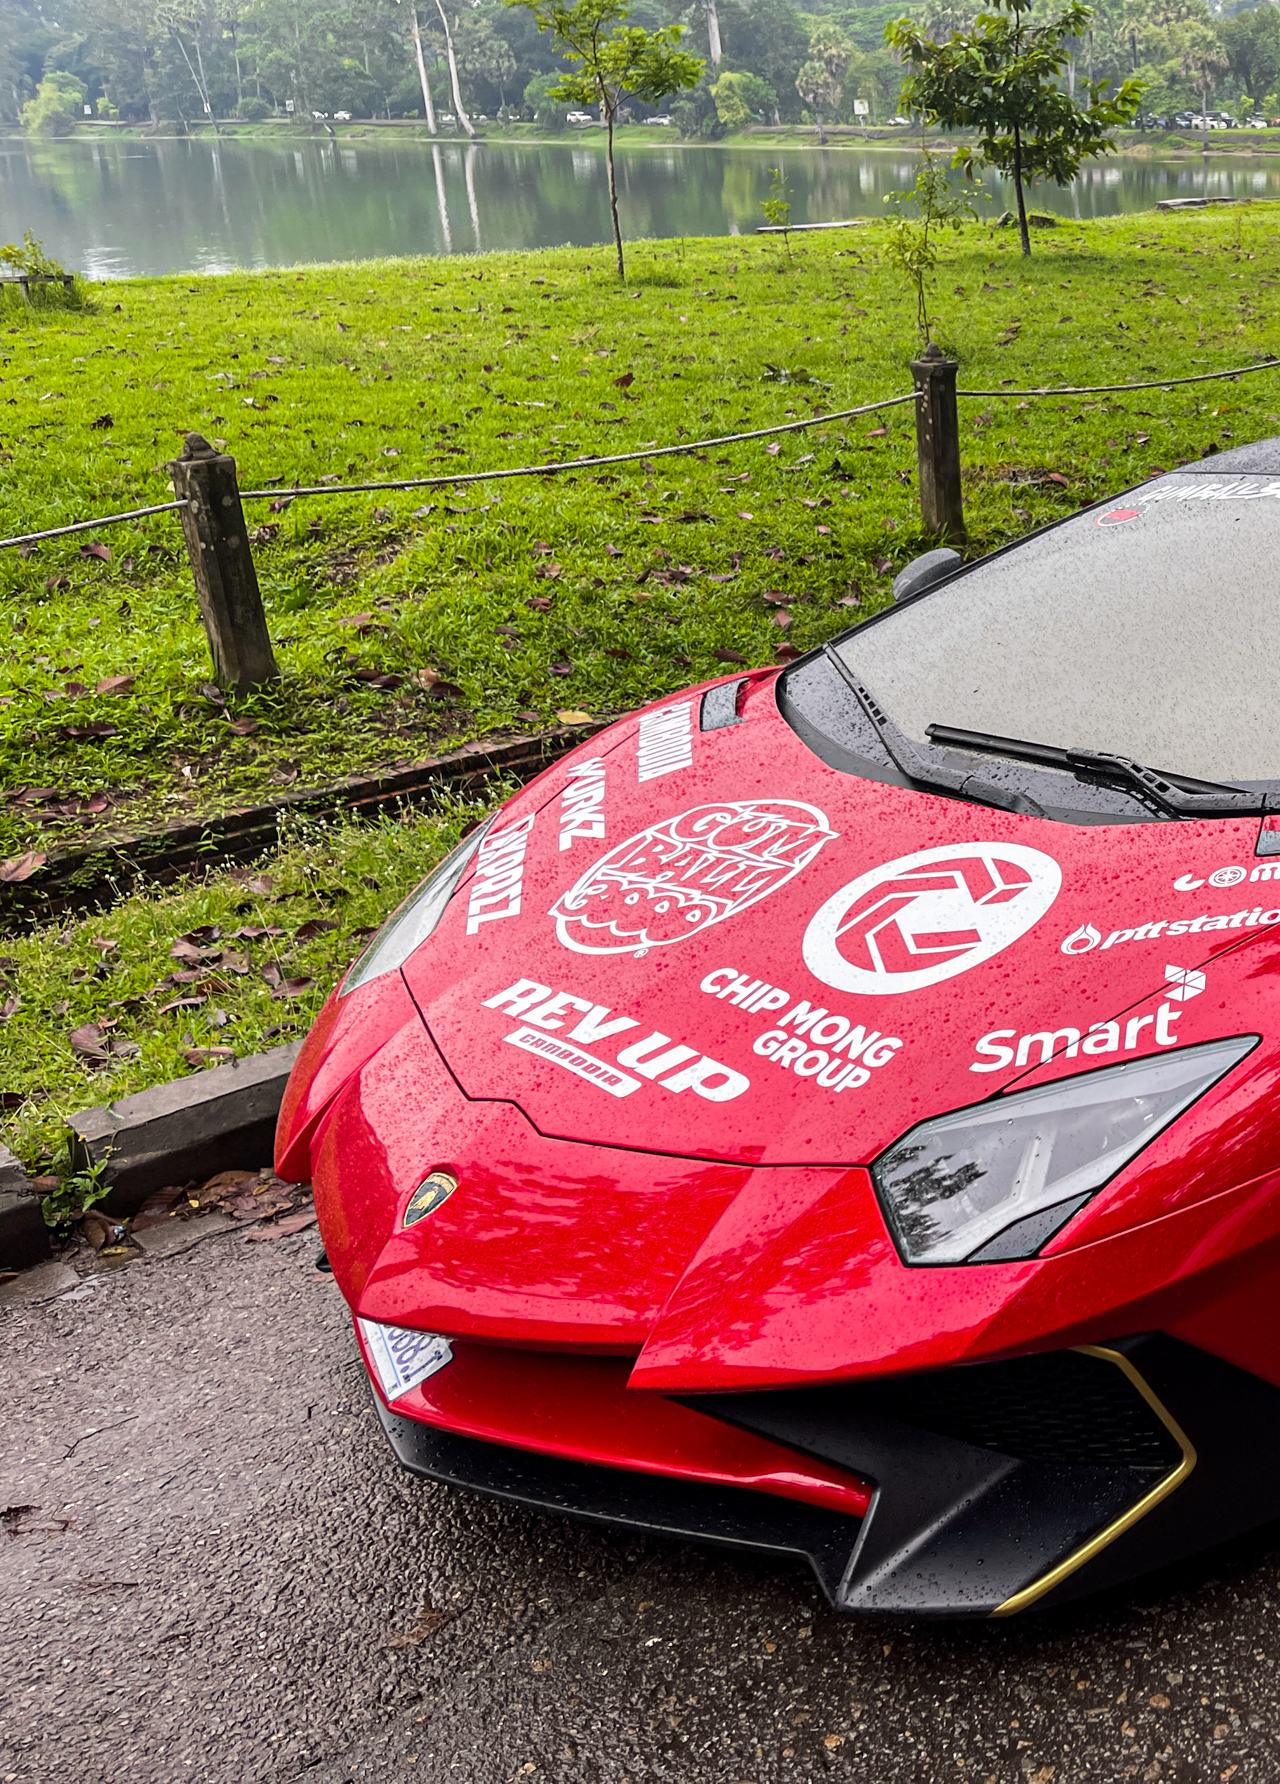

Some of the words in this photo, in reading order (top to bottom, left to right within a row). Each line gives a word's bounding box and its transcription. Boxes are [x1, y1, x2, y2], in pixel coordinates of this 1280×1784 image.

[638, 701, 693, 783] CAMBODIA
[481, 978, 640, 1048] REV
[618, 1030, 750, 1102] UP
[700, 967, 790, 1013] CHIP
[777, 999, 904, 1069] MONG
[518, 1032, 622, 1089] CAMBODIA
[753, 1029, 873, 1092] GROUP
